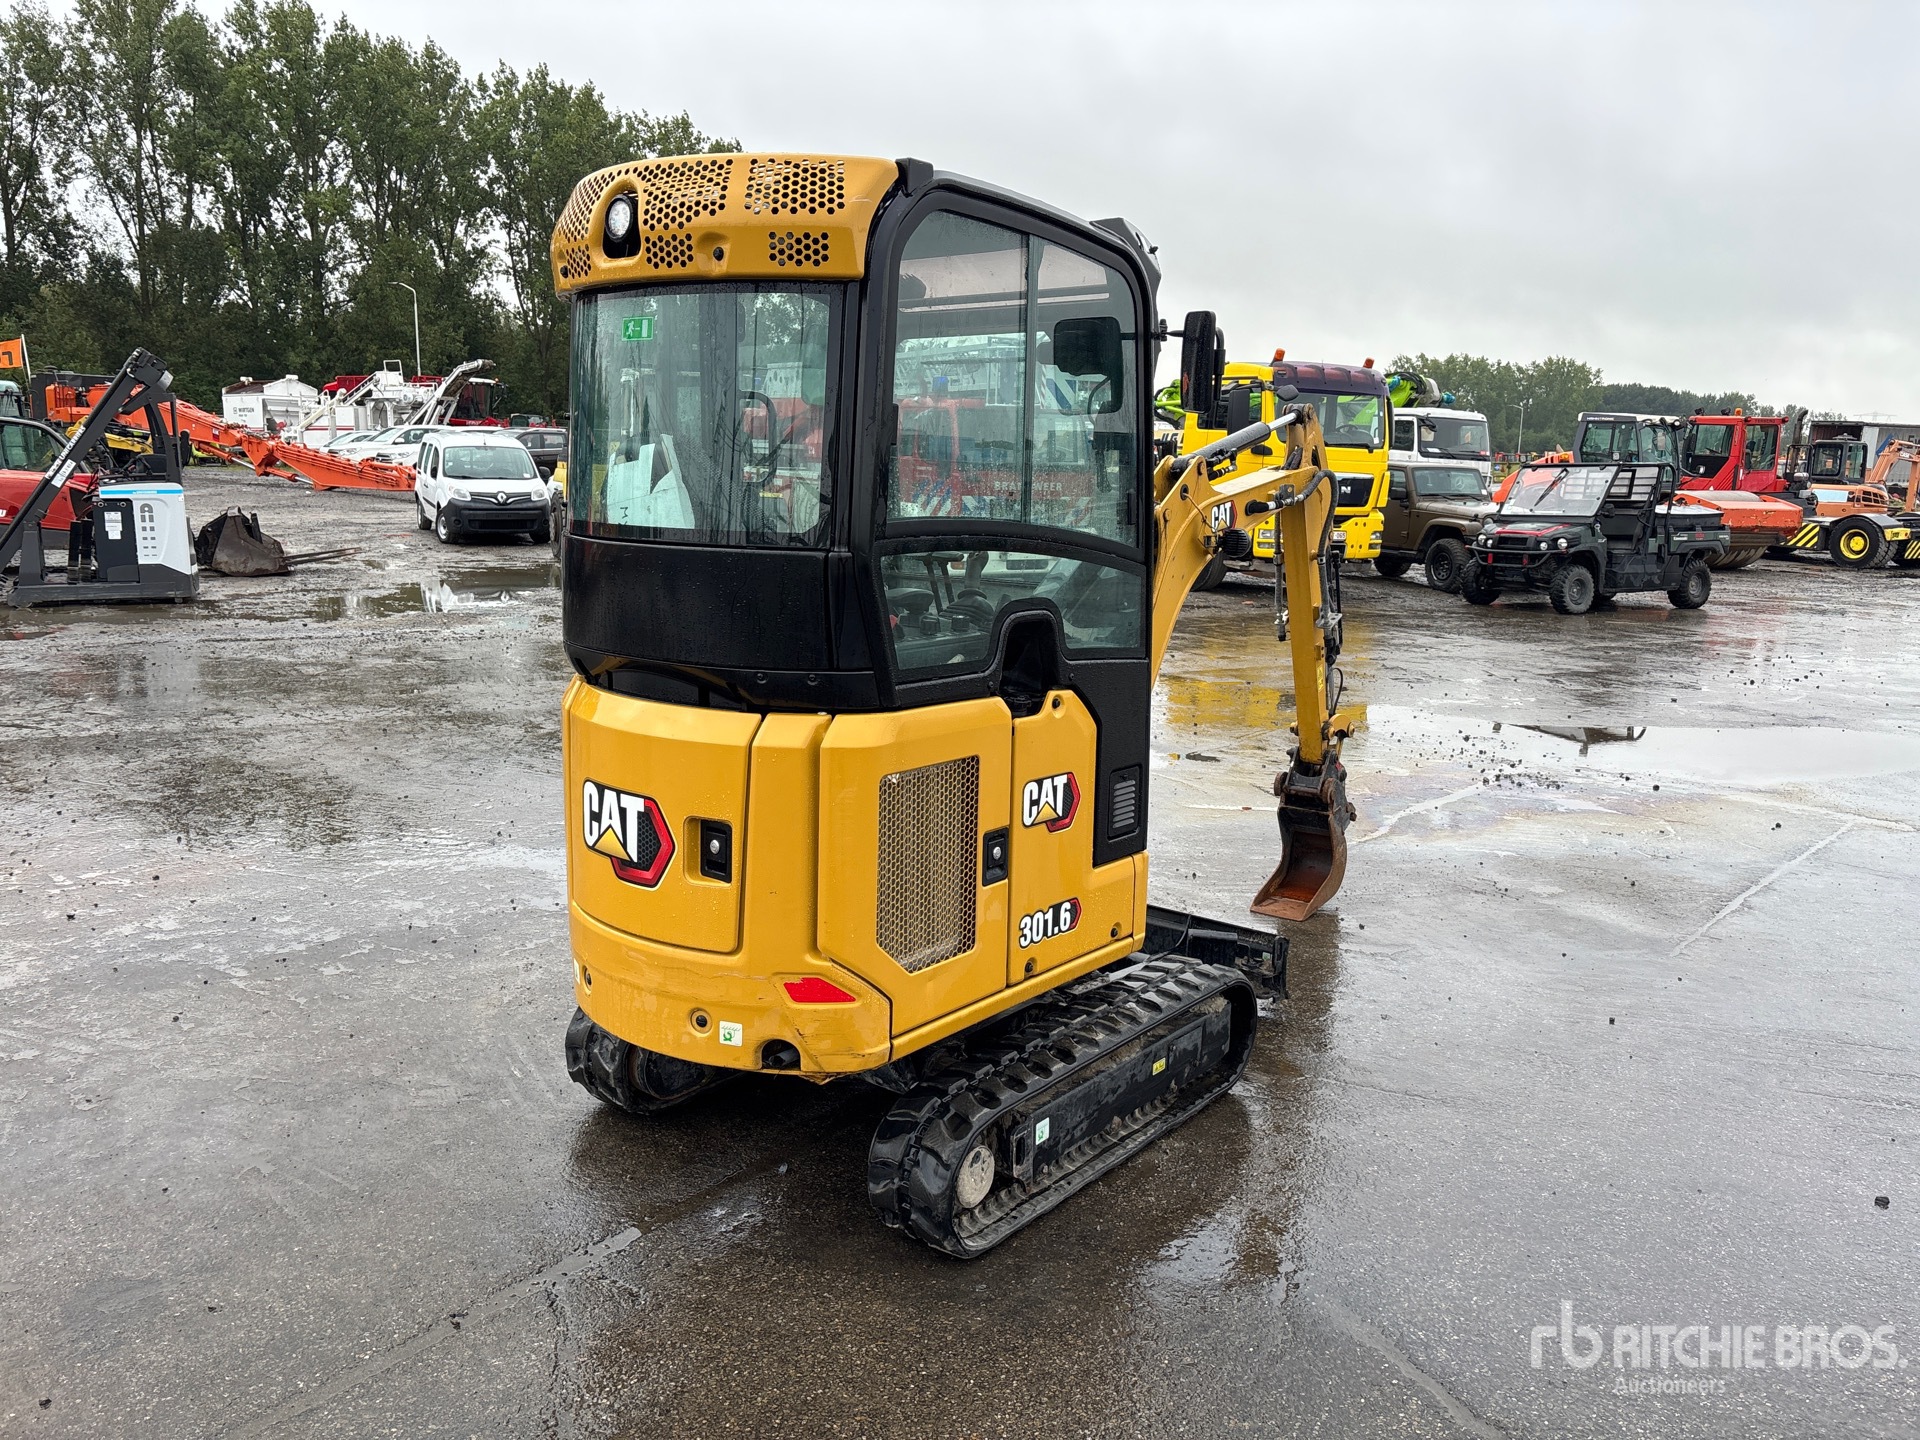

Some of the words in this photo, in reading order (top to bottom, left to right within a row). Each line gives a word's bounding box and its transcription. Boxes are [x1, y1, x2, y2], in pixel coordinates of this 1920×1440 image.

[1211, 501, 1232, 533] CAT
[582, 780, 645, 863] CAT
[1022, 773, 1068, 827] CAT
[1019, 900, 1072, 948] 301.6
